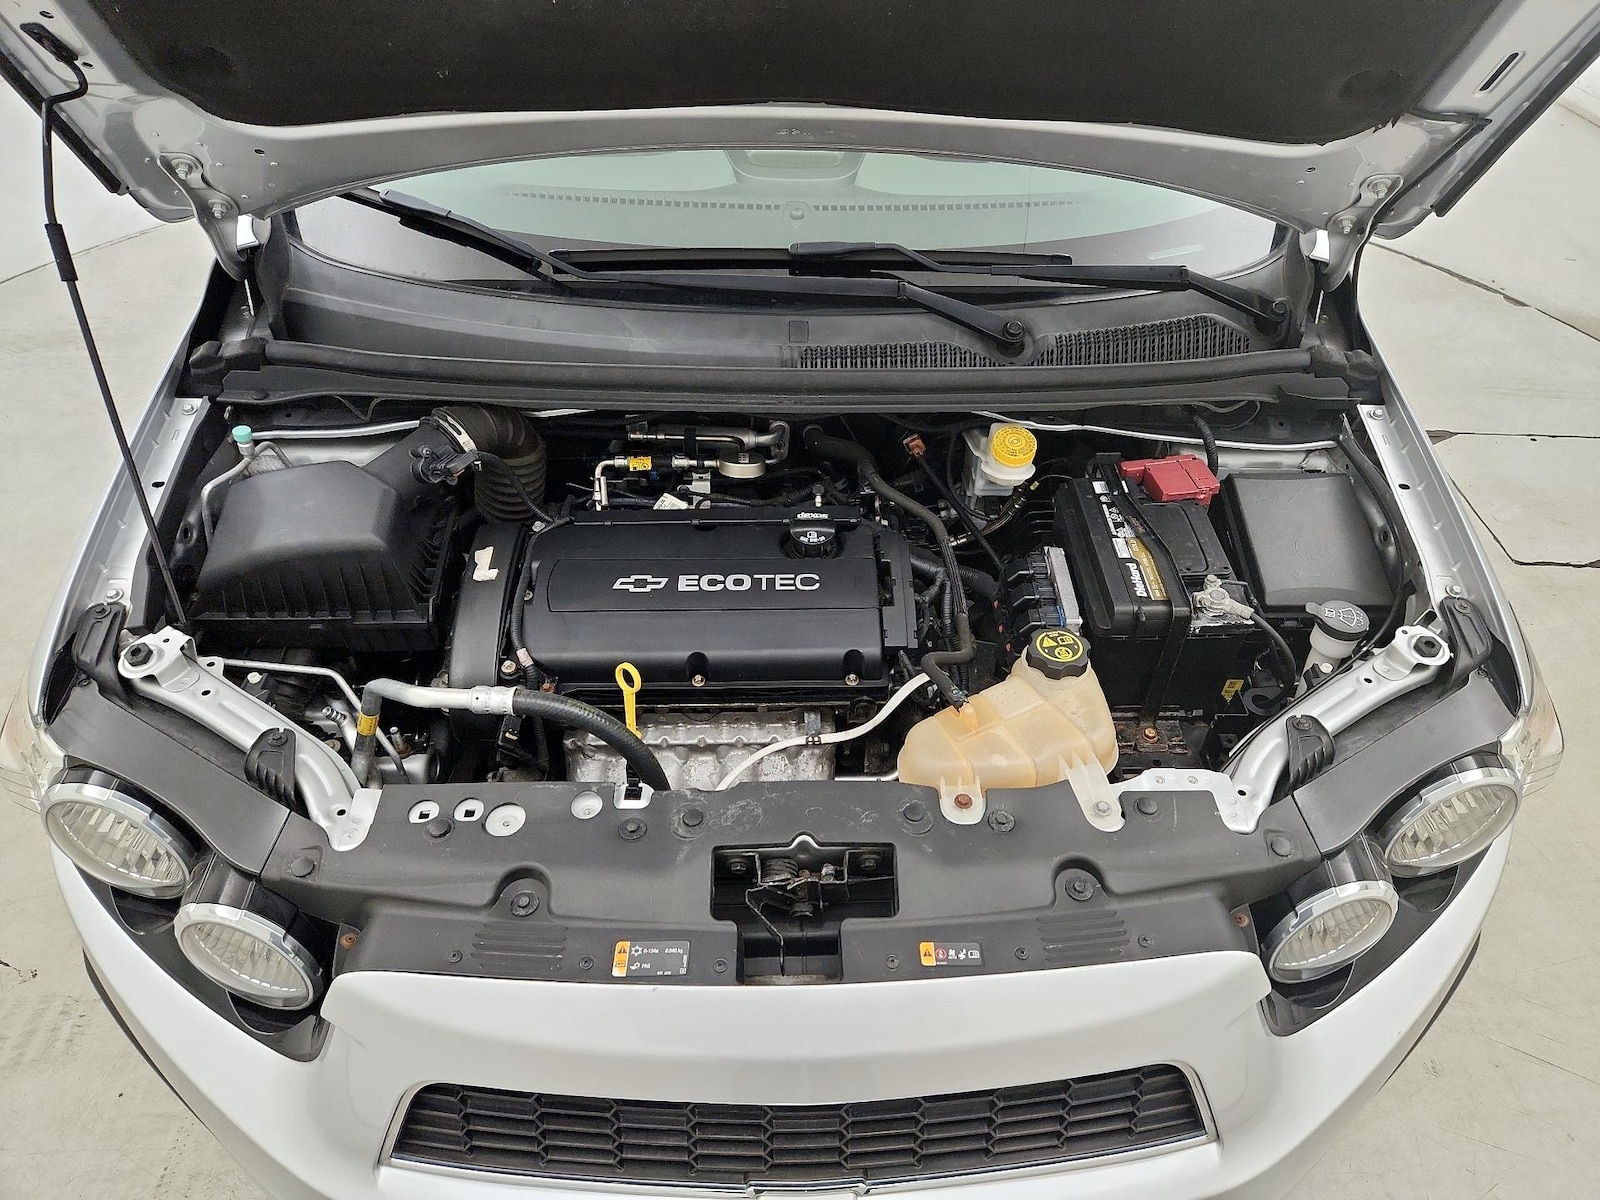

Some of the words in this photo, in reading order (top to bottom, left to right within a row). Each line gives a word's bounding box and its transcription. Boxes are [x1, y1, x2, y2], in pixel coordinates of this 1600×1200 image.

[796, 511, 829, 519] dexos
[677, 573, 821, 592] ECOTEC
[1125, 562, 1148, 598] DieHard
